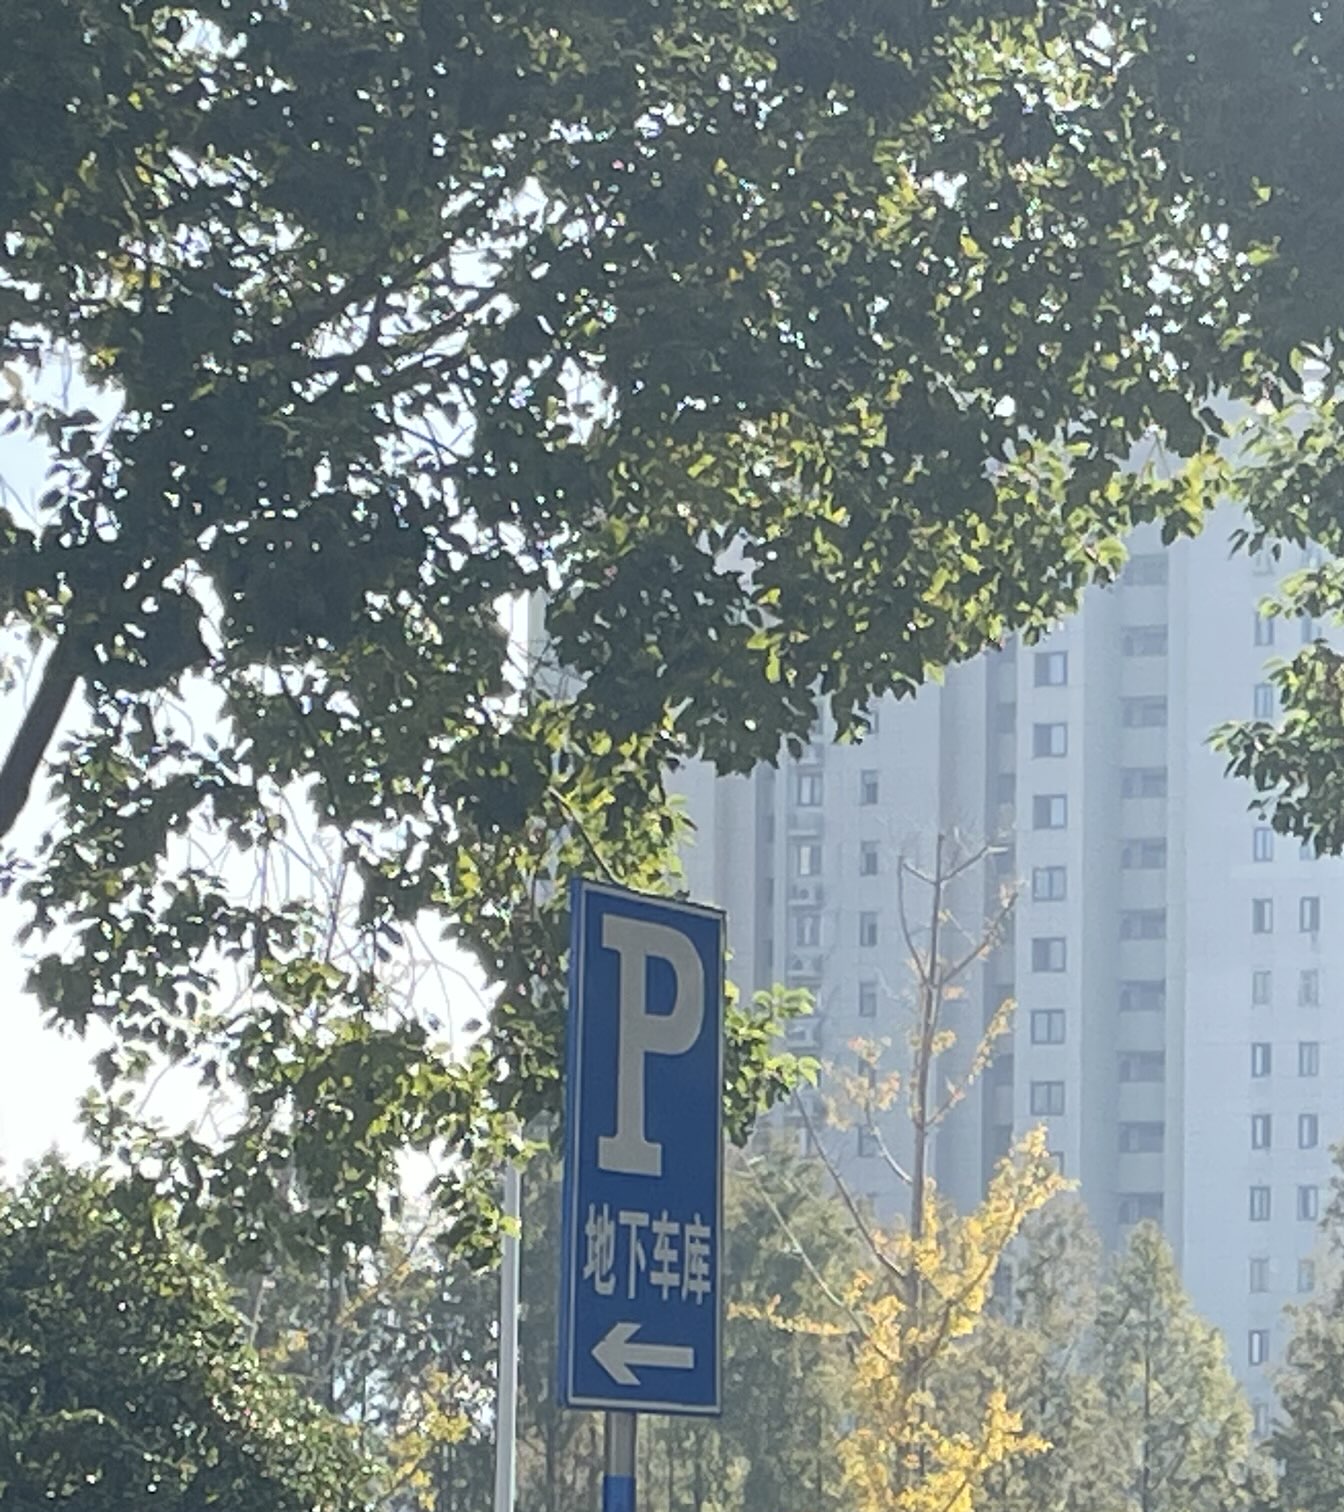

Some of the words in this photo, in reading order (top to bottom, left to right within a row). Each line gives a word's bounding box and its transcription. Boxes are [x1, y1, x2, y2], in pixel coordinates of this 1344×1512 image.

[598, 913, 705, 1177] P
[583, 1203, 713, 1305] 地下车库
